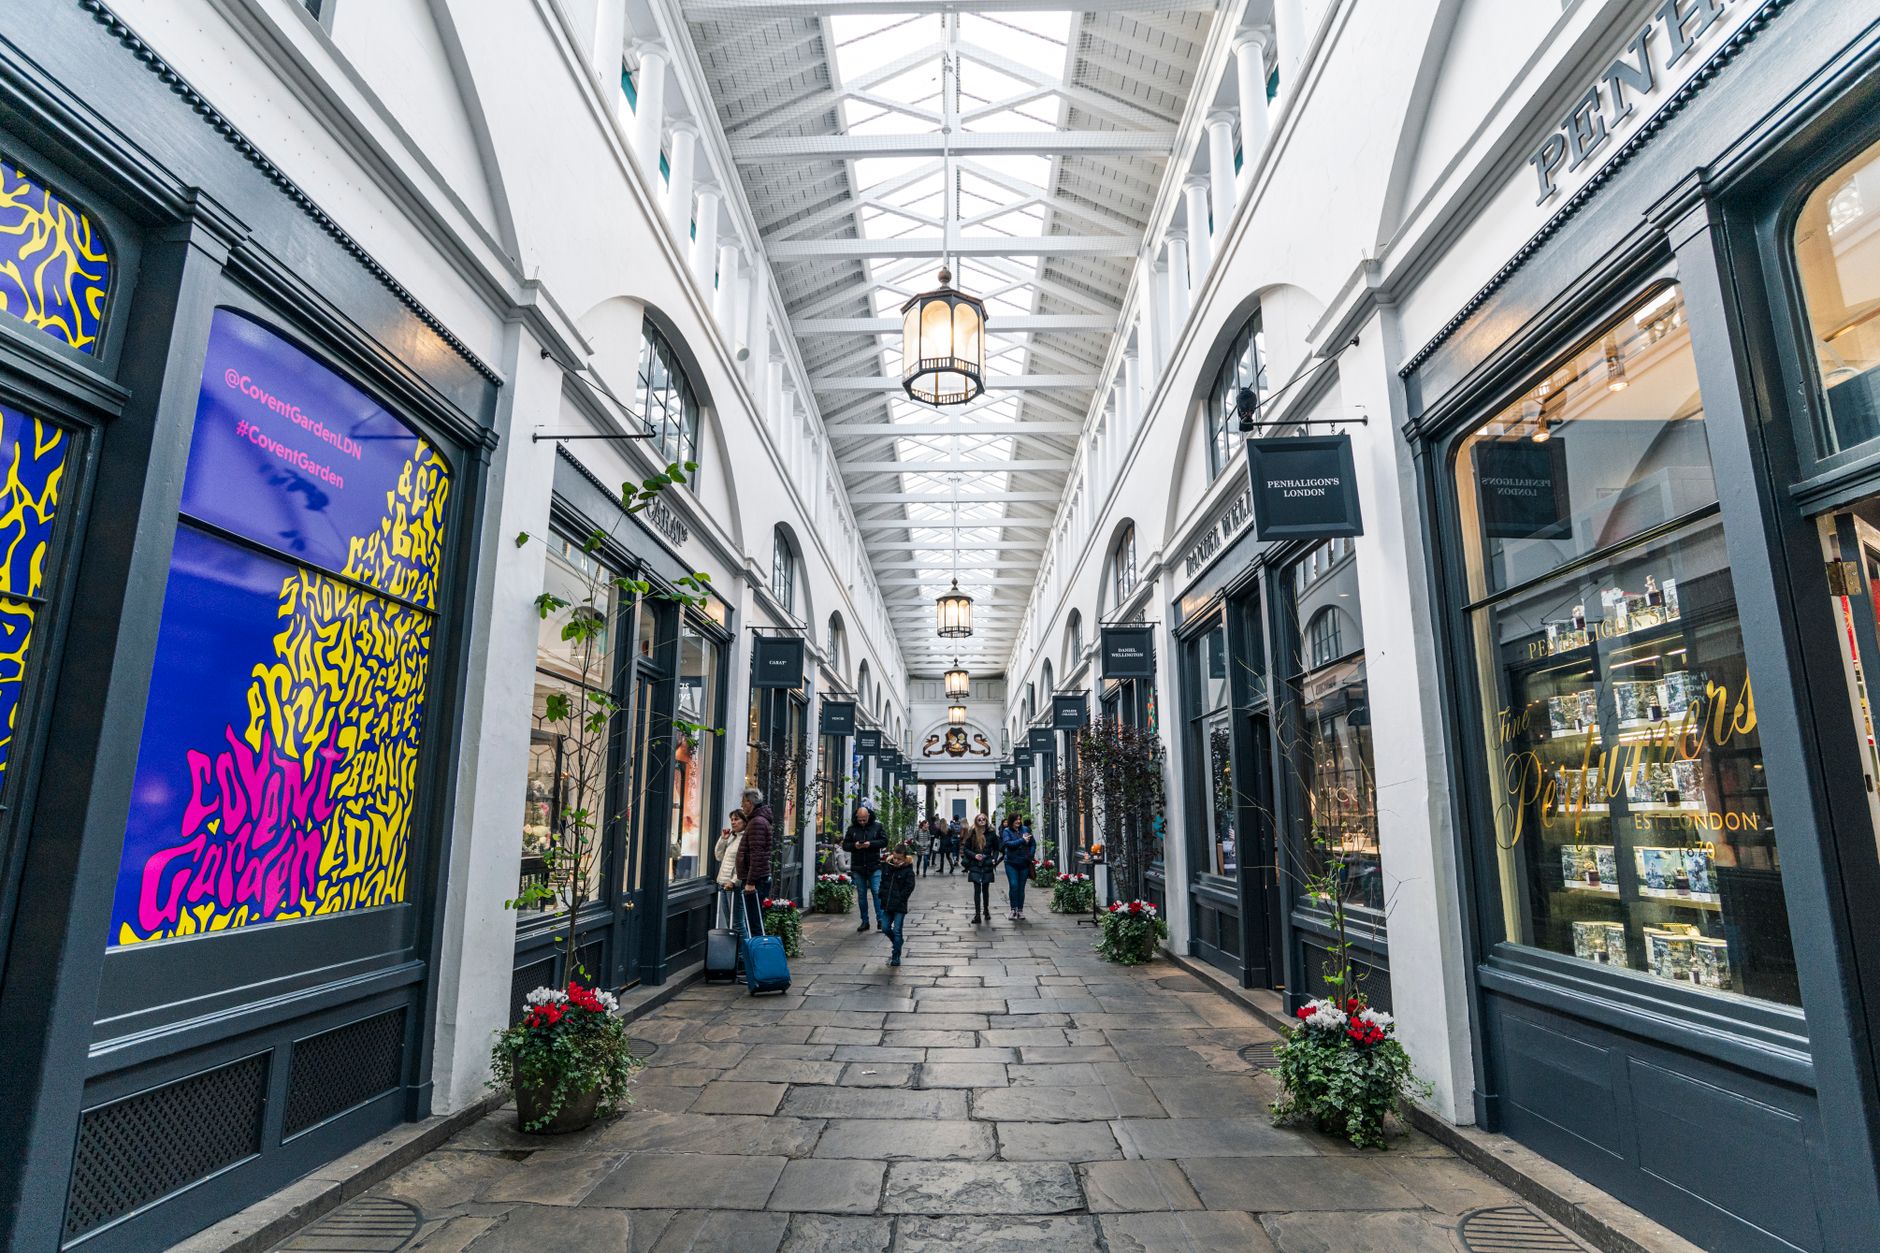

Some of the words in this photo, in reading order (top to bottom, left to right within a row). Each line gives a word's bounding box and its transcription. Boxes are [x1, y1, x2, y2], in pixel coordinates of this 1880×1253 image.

[225, 368, 362, 461] @CoventGardenLDN
[236, 419, 344, 489] #CoventGarden
[1267, 477, 1340, 488] PENHALIGON'S
[1283, 488, 1325, 497] LONDON
[1186, 526, 1221, 579] DANIEL
[1492, 704, 1532, 750] Fine
[1495, 667, 1758, 850] Perfumers
[1669, 812, 1759, 831] LONDON
[1680, 841, 1716, 860] 1870
